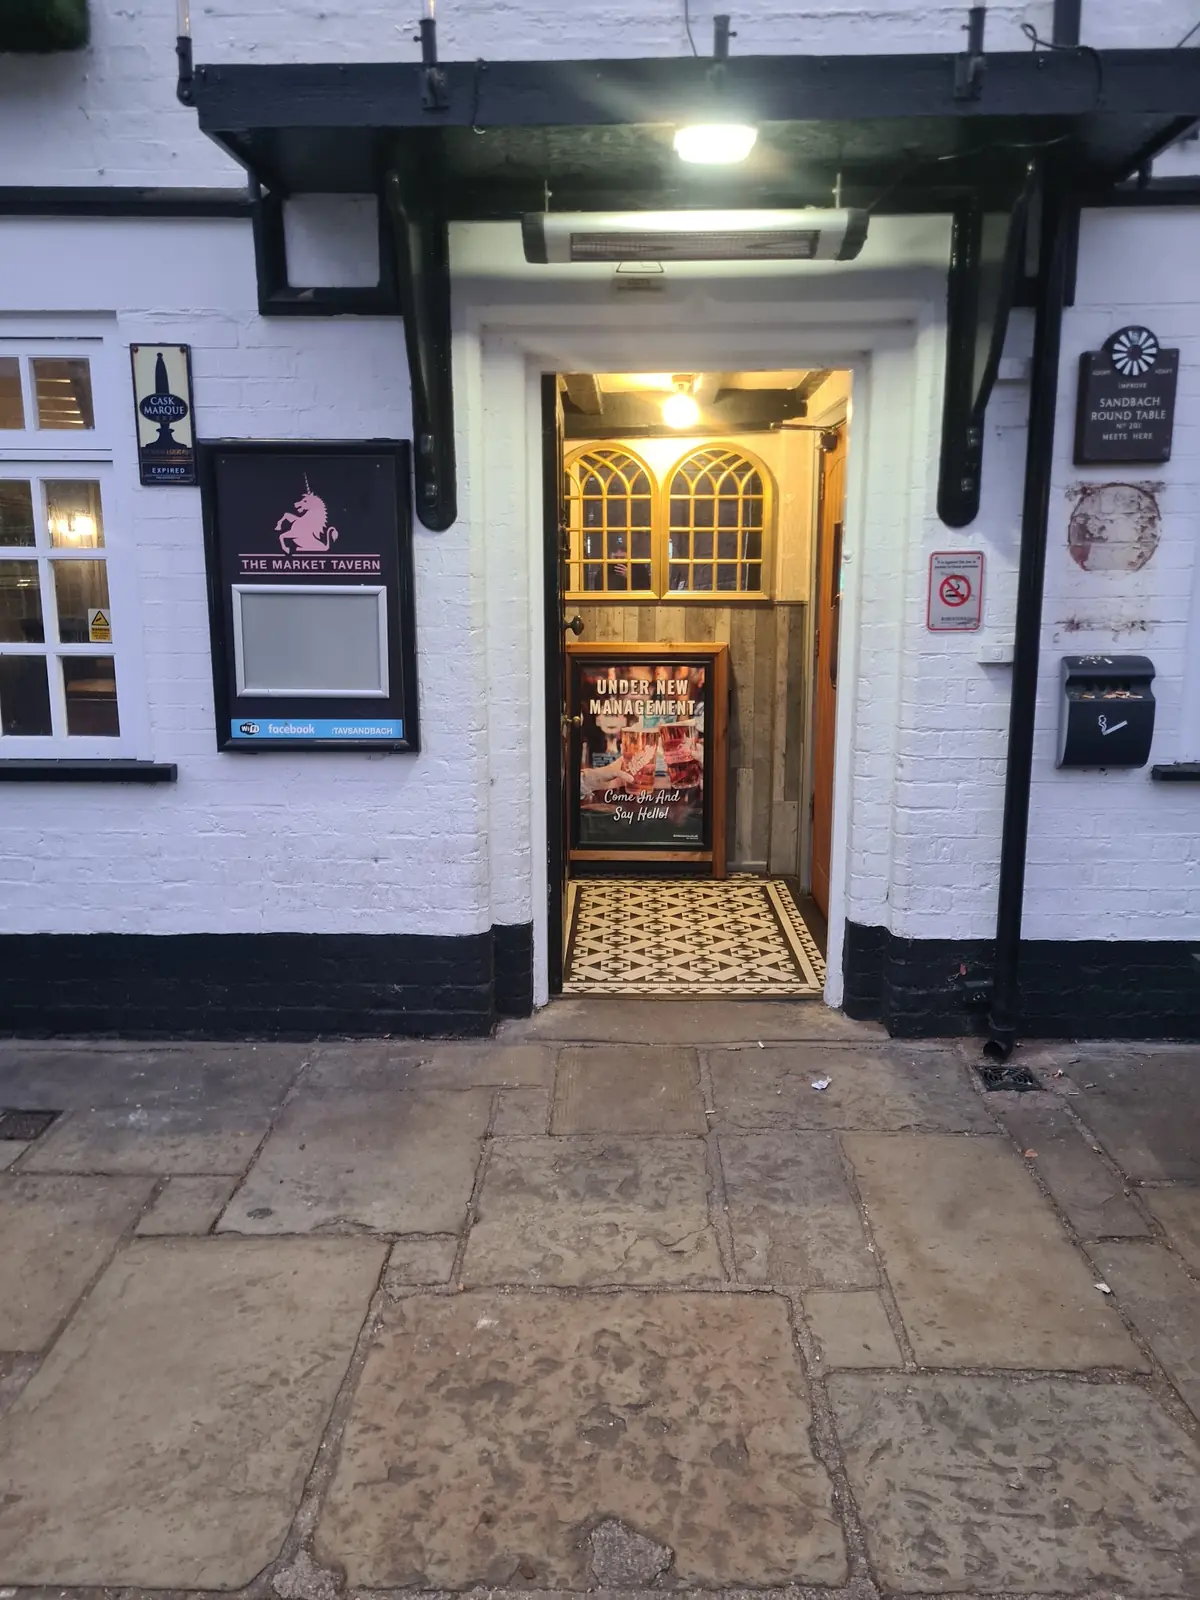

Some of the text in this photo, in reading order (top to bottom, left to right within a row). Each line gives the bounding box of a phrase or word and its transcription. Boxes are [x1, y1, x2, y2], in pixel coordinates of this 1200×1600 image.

[150, 397, 175, 405] CASK
[1100, 397, 1160, 407] SANDBACH
[144, 406, 184, 415] MARQUE
[1091, 410, 1166, 420] ROUND TABLE
[242, 560, 380, 569] THE MARKET TAVERN
[597, 680, 689, 695] UNDER NEW
[589, 700, 695, 715] MANAGEMENT
[268, 724, 315, 733] facebook
[604, 790, 680, 804] Come In And
[613, 807, 669, 824] Say Hello!
